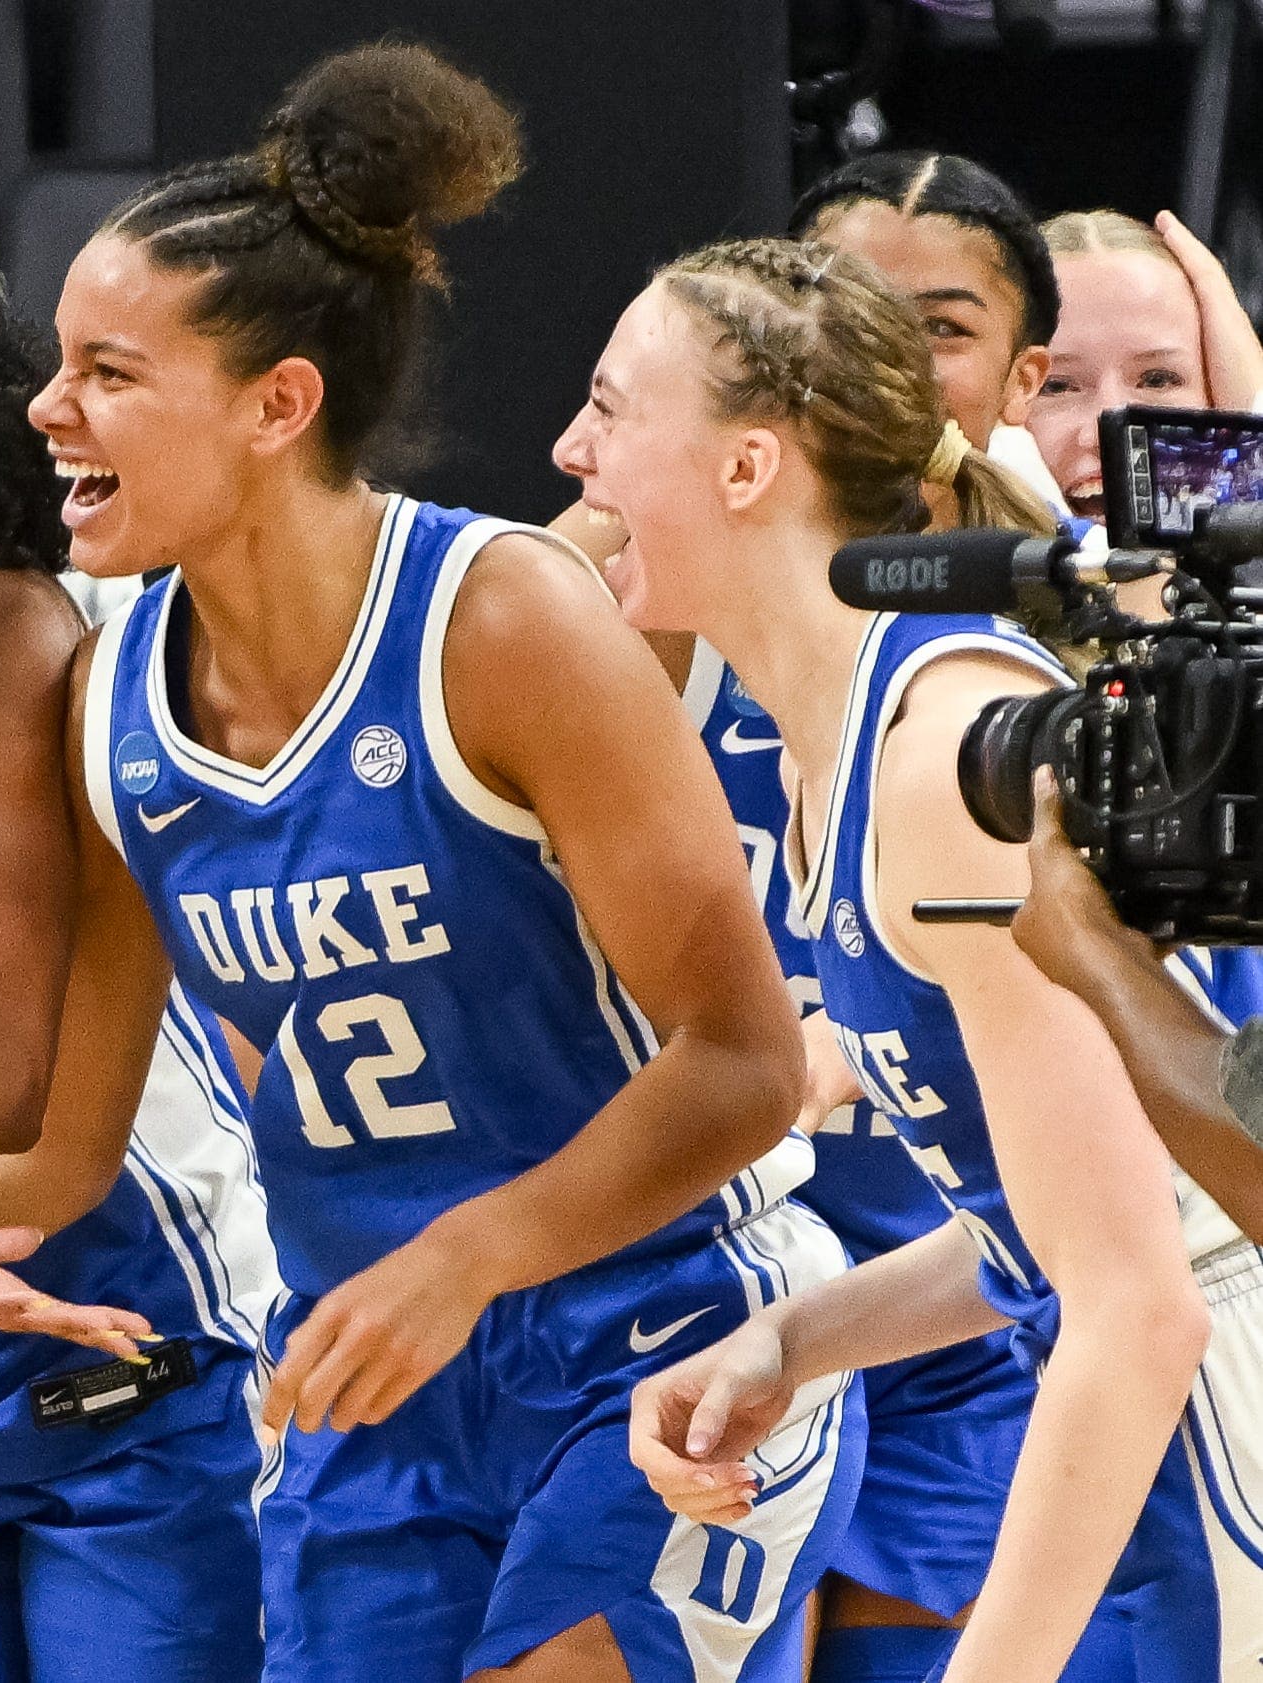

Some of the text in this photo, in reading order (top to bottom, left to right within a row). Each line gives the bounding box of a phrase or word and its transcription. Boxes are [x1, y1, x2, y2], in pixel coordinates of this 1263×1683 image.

[121, 758, 158, 781] NCAA
[360, 740, 401, 763] ACC
[179, 863, 452, 983] DUKE
[276, 993, 457, 1148] 12
[688, 1522, 767, 1624] D
